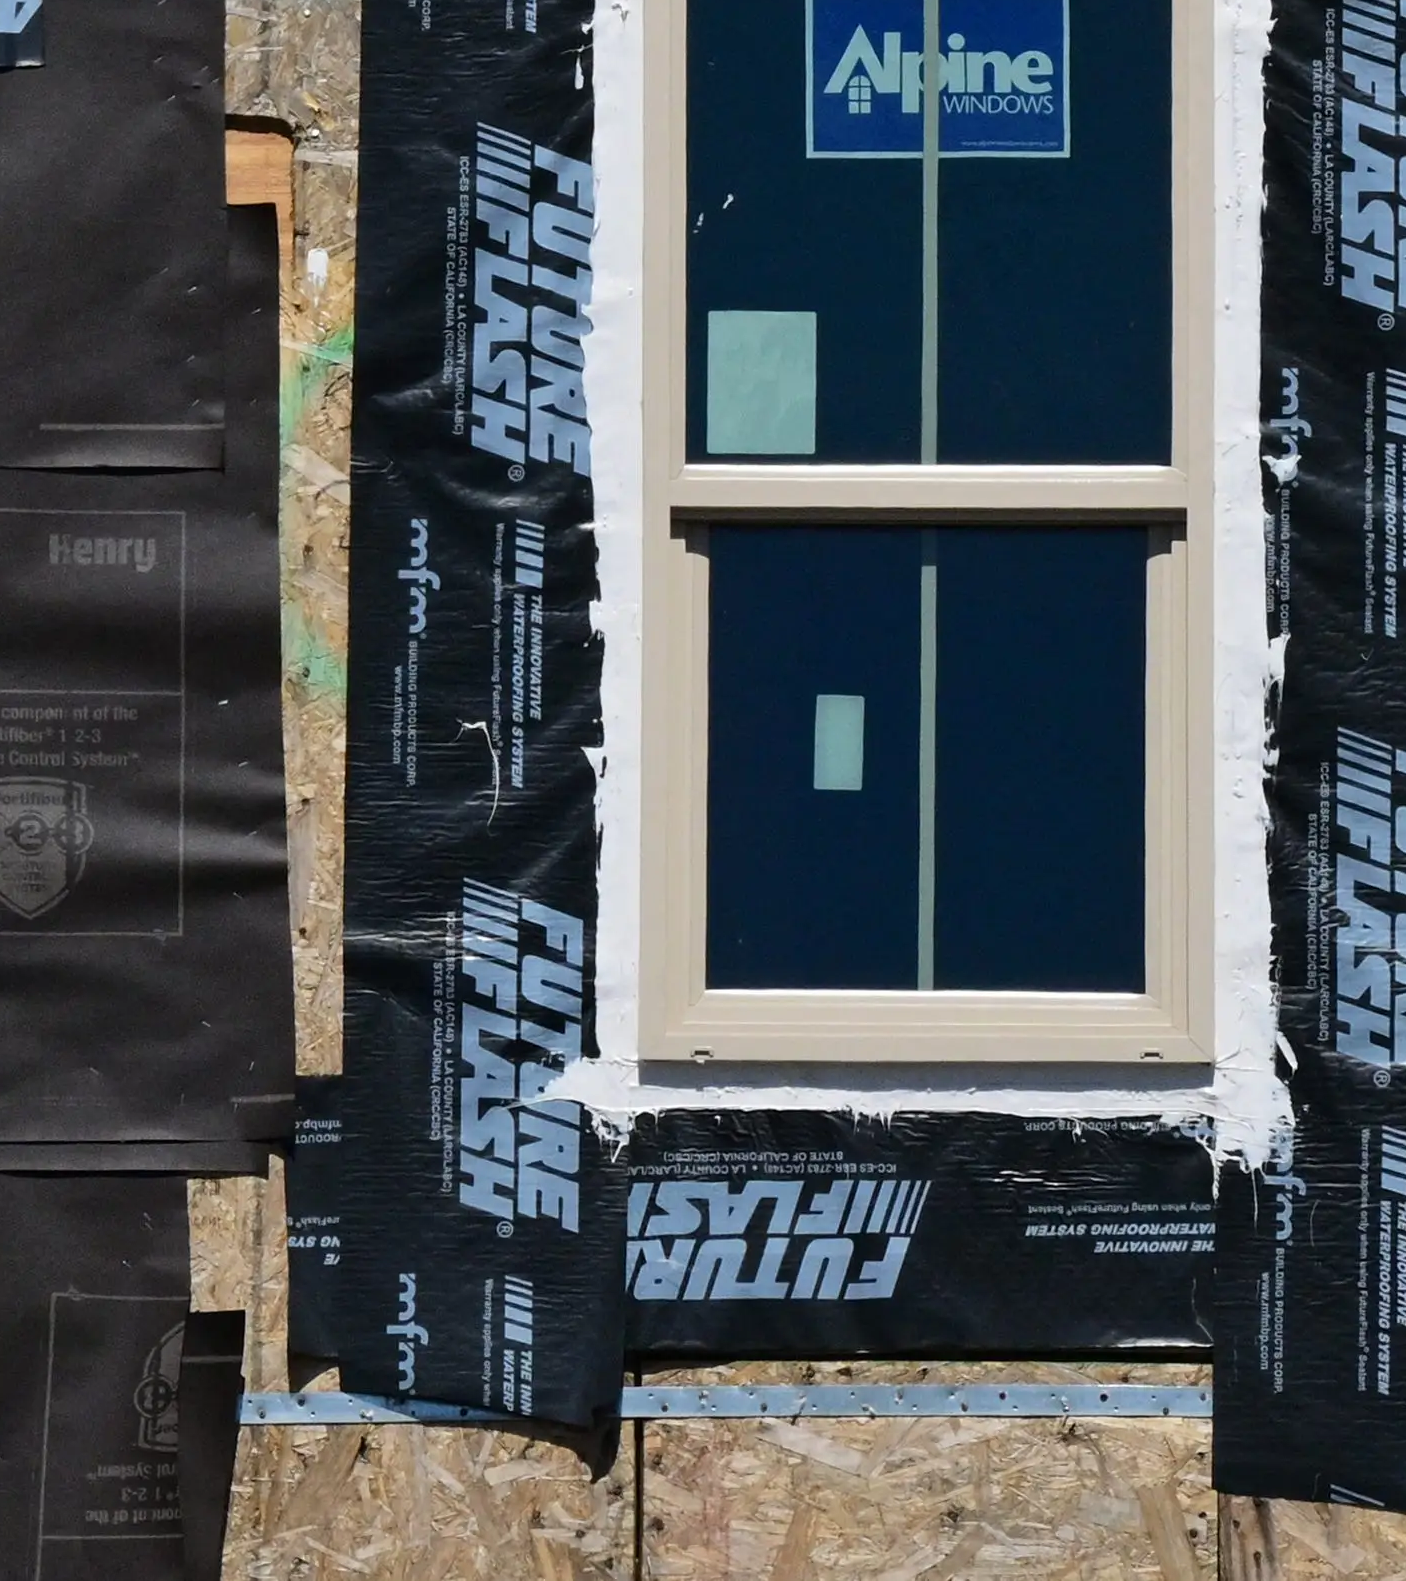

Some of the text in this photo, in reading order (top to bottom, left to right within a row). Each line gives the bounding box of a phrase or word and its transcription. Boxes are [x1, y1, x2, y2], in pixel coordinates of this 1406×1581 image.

[823, 23, 1054, 114] Alpine
[943, 95, 1054, 114] WINDOWS
[1310, 59, 1323, 235] STATE OF CALIFORNIA (CRC/CBC)
[1322, 8, 1336, 287] ICC-ES ESR-2783 (AC148) LA COUNTY (LARC/LABC)
[529, 144, 594, 476] FUTURE
[48, 533, 157, 573] Henry
[397, 519, 441, 635] mfm
[1385, 441, 1398, 638] WATERPROOFING SYSTEM
[405, 641, 418, 788] BUILDING PRODUCTS CORP.
[511, 593, 527, 789] WATERPROOFING SYSTEM
[529, 594, 544, 722] THE INNOVATIVE
[626, 1237, 911, 1300] FUTUR
[1025, 1223, 1087, 1238] SYSTEM
[1094, 1239, 1188, 1253] INNOVATIVE
[386, 1273, 430, 1392] mfm
[1259, 1272, 1270, 1370] www.mfmbp.com
[1272, 1247, 1285, 1394] BUILDING PRODUCTS CORP.
[1377, 1200, 1393, 1396] WATERPROOFING SYSTEM
